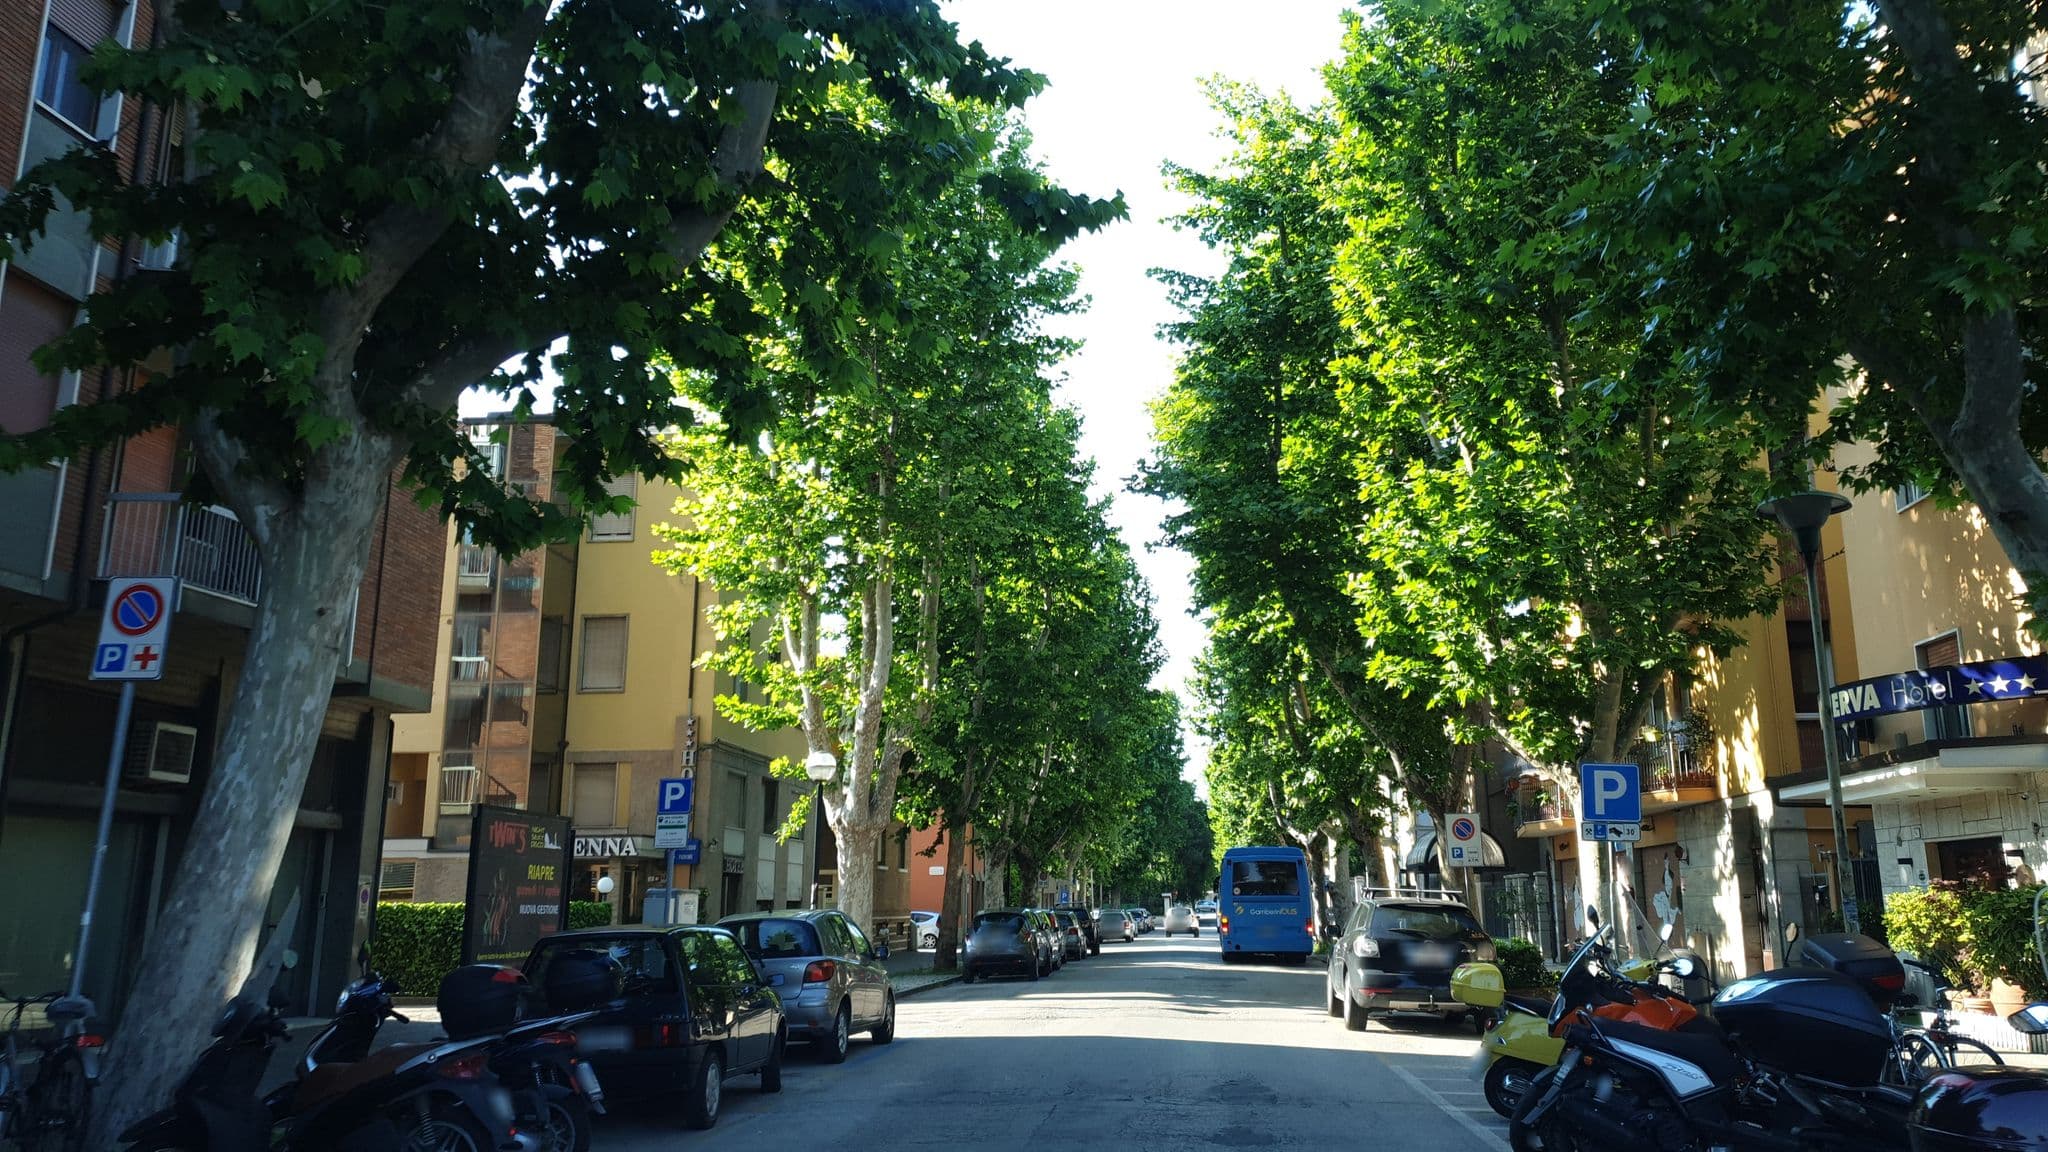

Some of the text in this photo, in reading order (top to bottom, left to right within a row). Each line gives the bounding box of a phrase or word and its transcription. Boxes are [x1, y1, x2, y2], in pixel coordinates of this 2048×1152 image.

[101, 647, 121, 670] P
[1890, 671, 1954, 707] Hotel
[664, 782, 685, 810] P
[1593, 769, 1627, 815] P
[1453, 848, 1461, 858] P
[528, 864, 556, 881] RIAPRE
